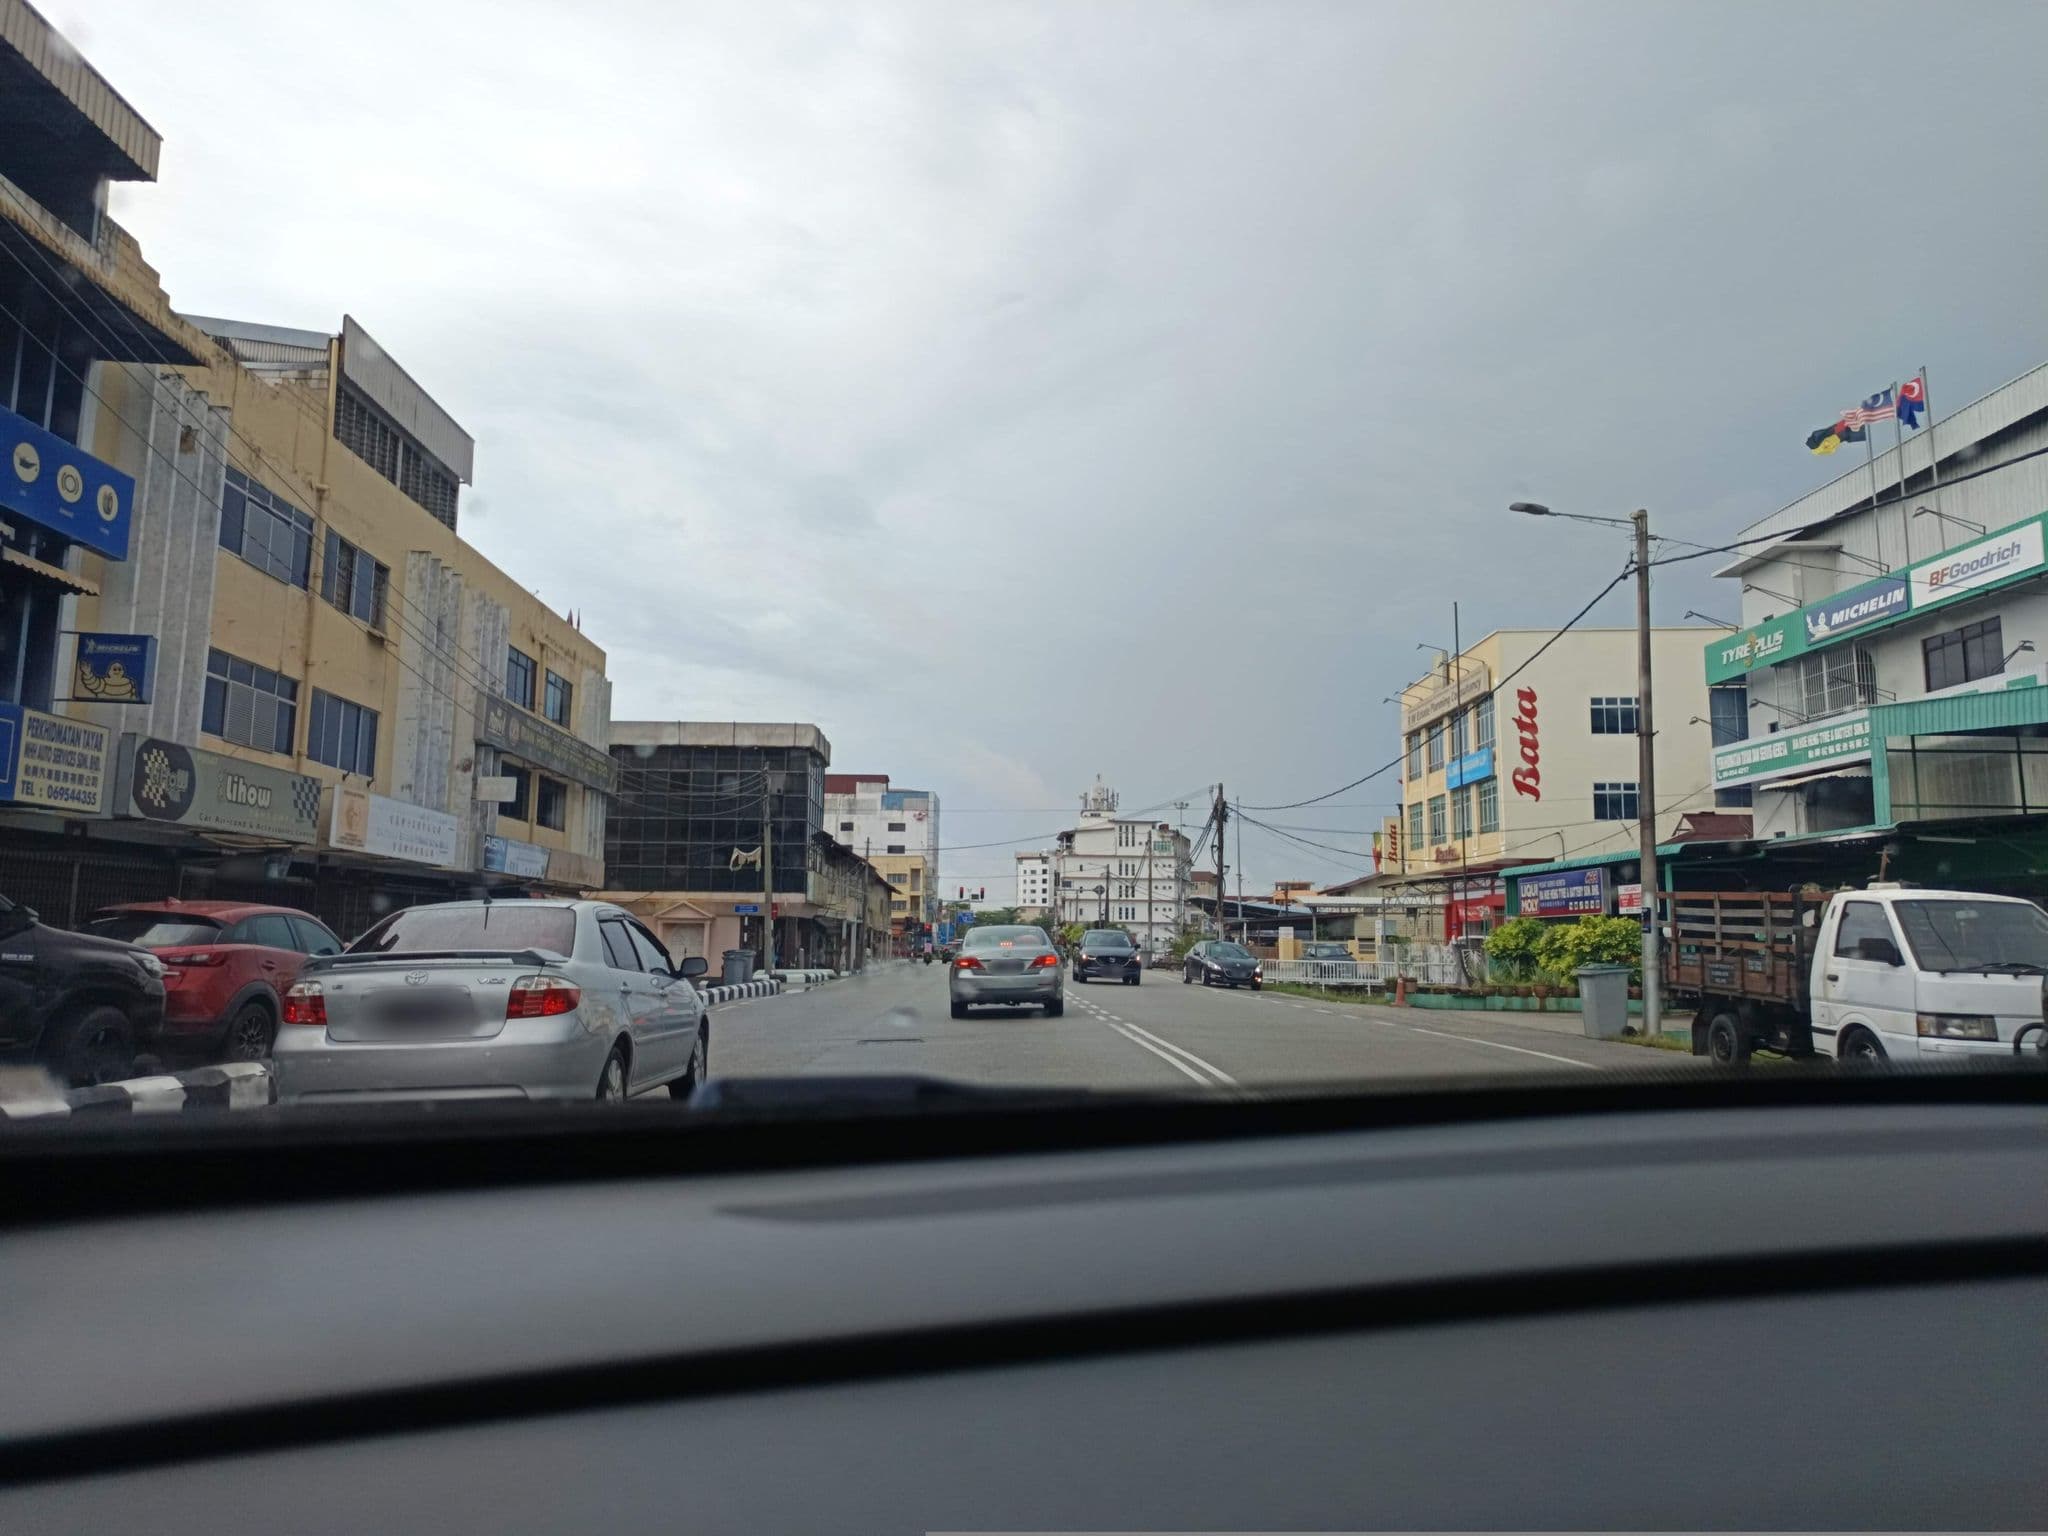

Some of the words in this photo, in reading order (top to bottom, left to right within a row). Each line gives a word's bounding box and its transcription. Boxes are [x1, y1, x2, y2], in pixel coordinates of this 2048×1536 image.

[1929, 541, 2021, 587] BFGoodrich
[1831, 587, 1905, 626] MICHELIN
[1754, 630, 1783, 653] PLUS
[27, 716, 81, 747] PERKHIDMATAN
[1512, 686, 1541, 802] Bata
[22, 780, 35, 796] TEL
[1388, 824, 1398, 864] Bata
[1521, 898, 1538, 912] MOLY
